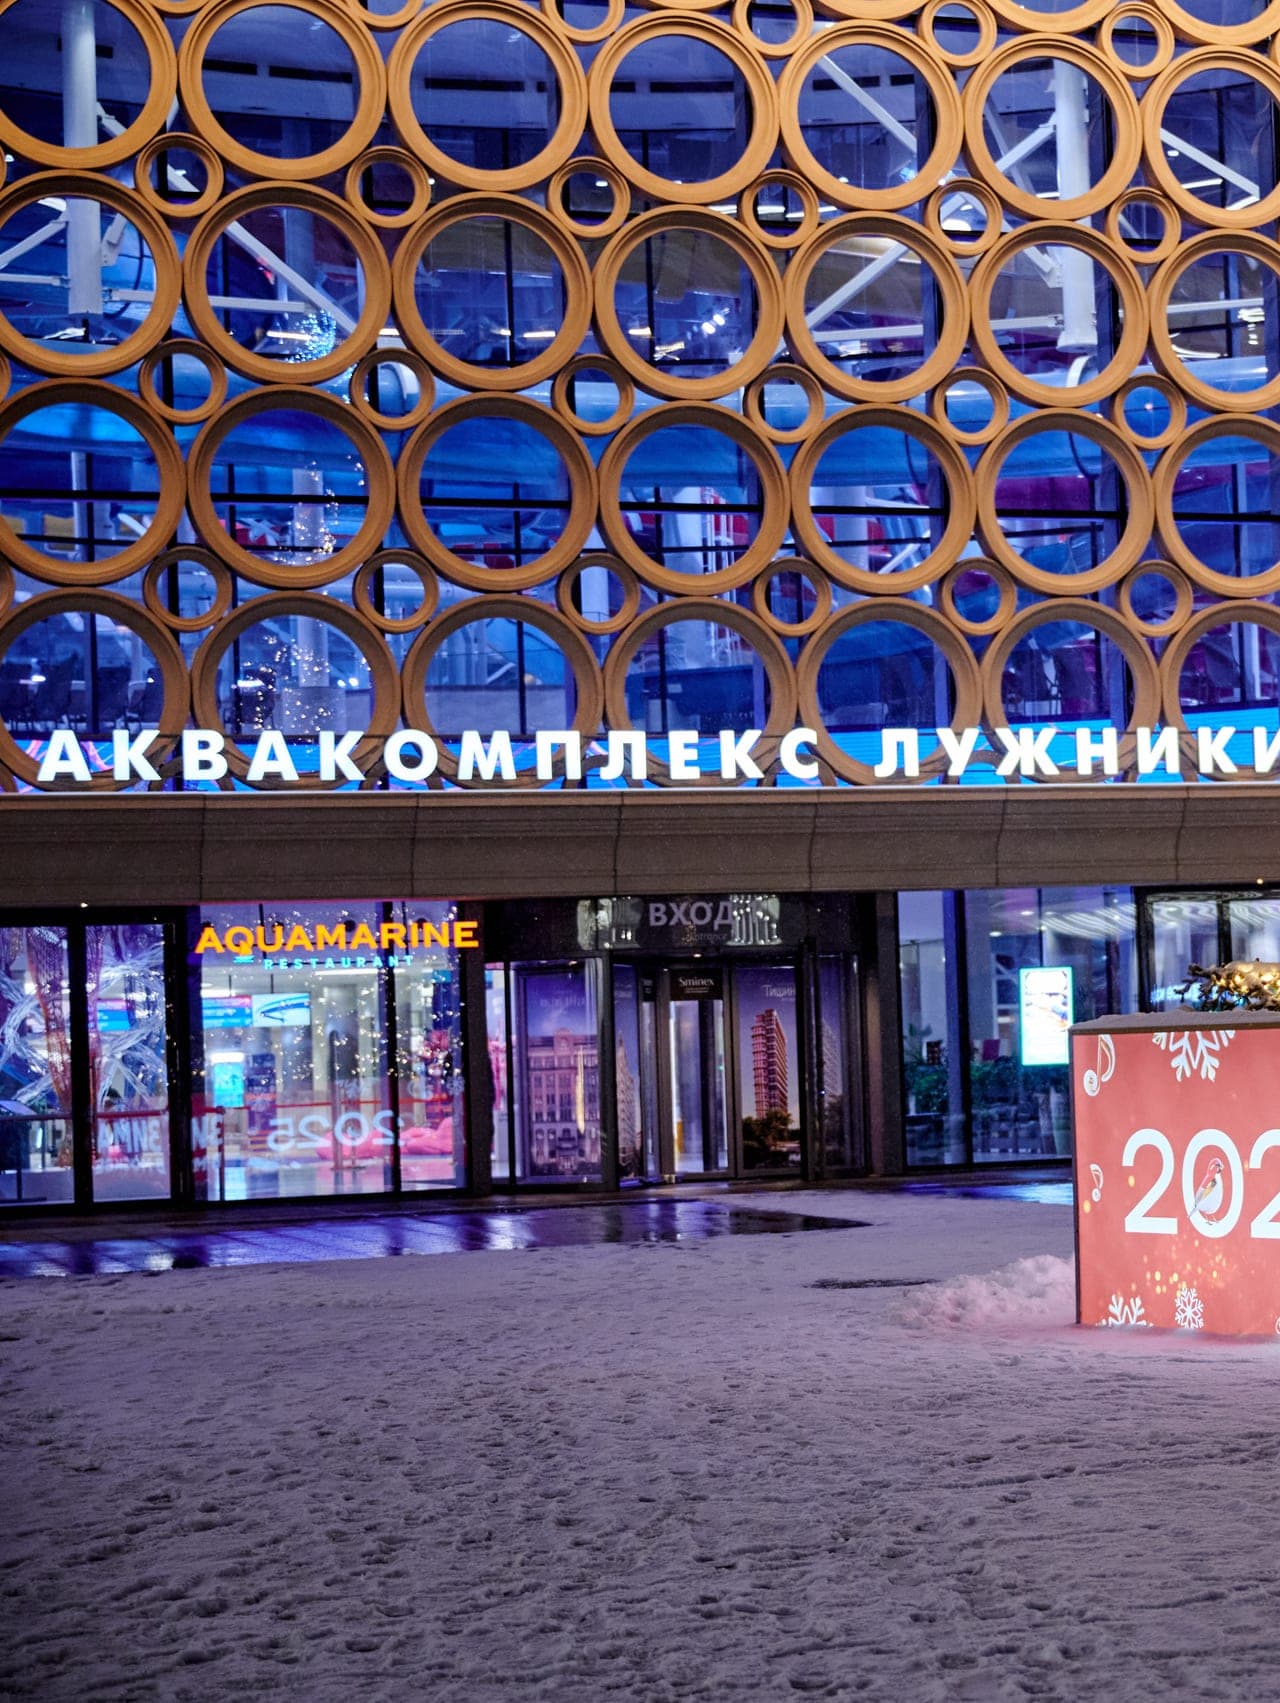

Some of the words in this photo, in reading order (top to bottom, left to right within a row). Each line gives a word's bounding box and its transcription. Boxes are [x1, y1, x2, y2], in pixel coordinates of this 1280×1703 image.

[36, 727, 819, 783] АКВАКОМПЛЕКС
[650, 901, 736, 930] ВХОД
[195, 921, 480, 956] AQUAMARINE
[263, 955, 414, 970] RESTAURANT
[678, 976, 714, 987] Sminex
